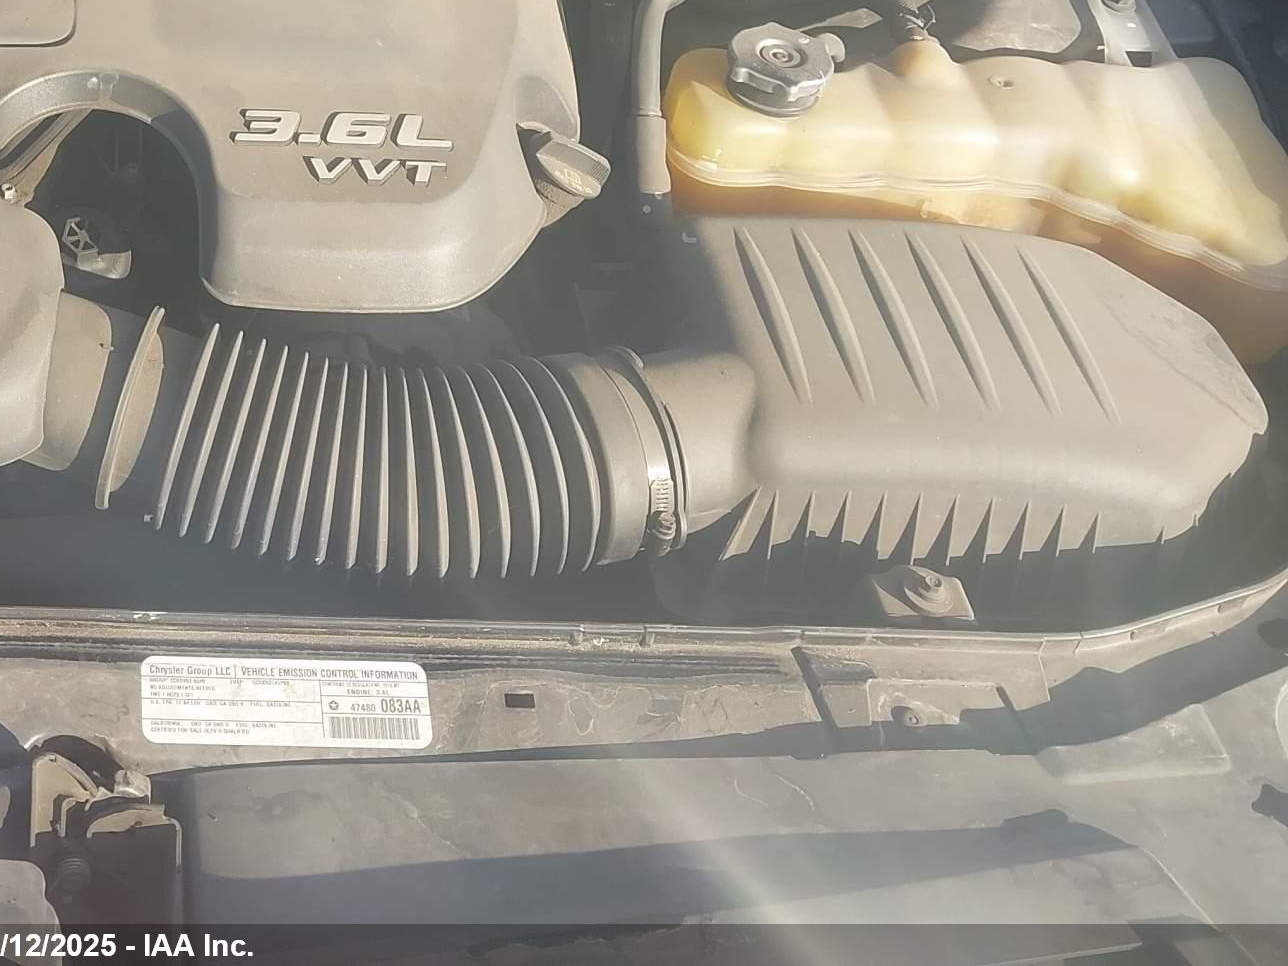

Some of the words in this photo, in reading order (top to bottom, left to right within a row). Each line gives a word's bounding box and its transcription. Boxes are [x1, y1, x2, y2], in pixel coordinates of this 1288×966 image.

[229, 108, 453, 151] 3.6L
[302, 155, 447, 186] VVT
[149, 664, 184, 677] Chrysler
[187, 665, 212, 677] Group
[215, 666, 231, 676] LLC
[241, 665, 274, 677] VEHICLE
[278, 667, 317, 678] EMISSION
[320, 668, 359, 679] CONTROL
[361, 669, 418, 681] INFORMATION
